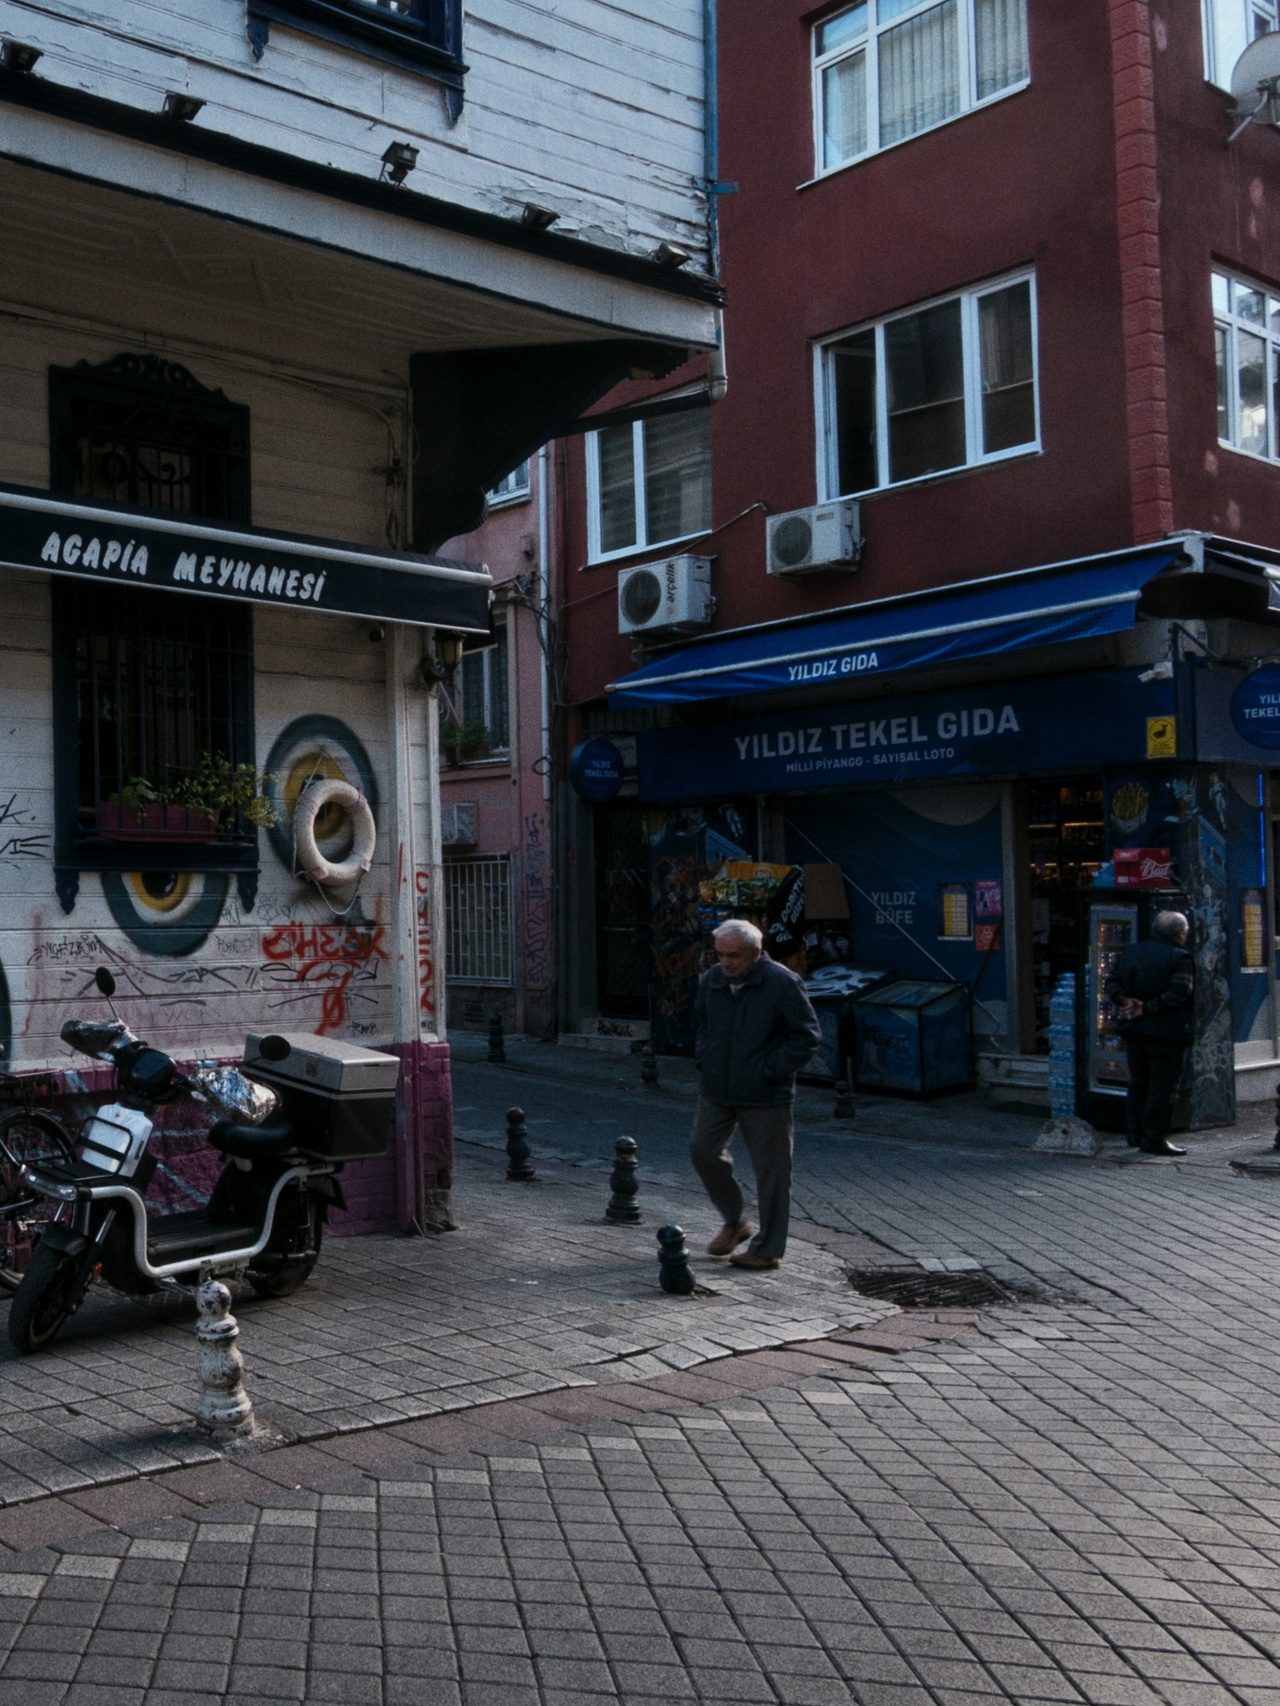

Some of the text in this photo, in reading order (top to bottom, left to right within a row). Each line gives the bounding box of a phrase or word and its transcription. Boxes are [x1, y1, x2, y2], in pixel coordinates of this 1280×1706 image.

[788, 652, 879, 681] YILDIZ GIDA
[1259, 694, 1280, 705] YIL
[734, 704, 1020, 760] YILDIZ TEKEL GIDA
[786, 757, 814, 773] MİLLİ
[816, 755, 864, 771] PİYANGO
[873, 750, 922, 765] SAYISAL
[924, 747, 956, 762] LOTO
[1141, 857, 1172, 879] Bud
[871, 891, 917, 906] YILDIZ
[875, 907, 914, 925] BÜFE
